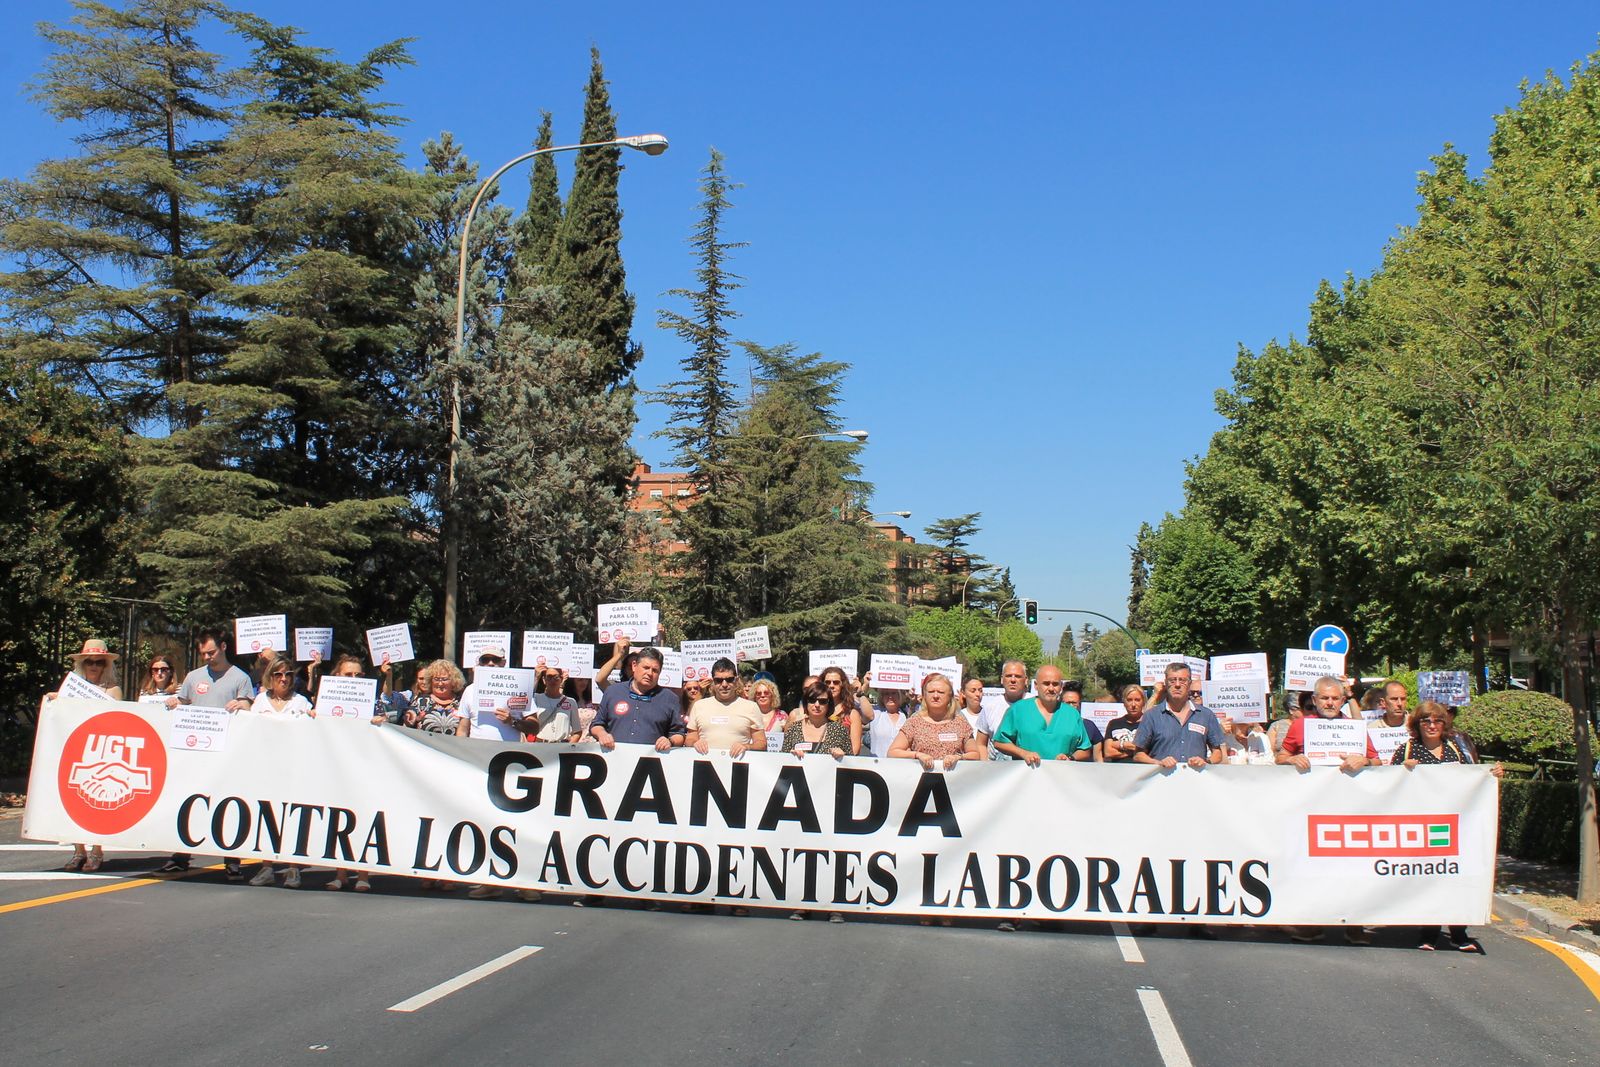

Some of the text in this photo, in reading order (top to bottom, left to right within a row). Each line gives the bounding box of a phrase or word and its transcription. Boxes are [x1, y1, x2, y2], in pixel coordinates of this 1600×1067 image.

[479, 689, 528, 697] RESPONSABLES
[82, 734, 144, 767] UGT
[487, 750, 962, 838] GRANADA
[1317, 823, 1424, 849] CCOO
[177, 793, 1271, 917] CONTRA LOS ACCIDENTES LABORALES
[1374, 859, 1459, 876] Granada
